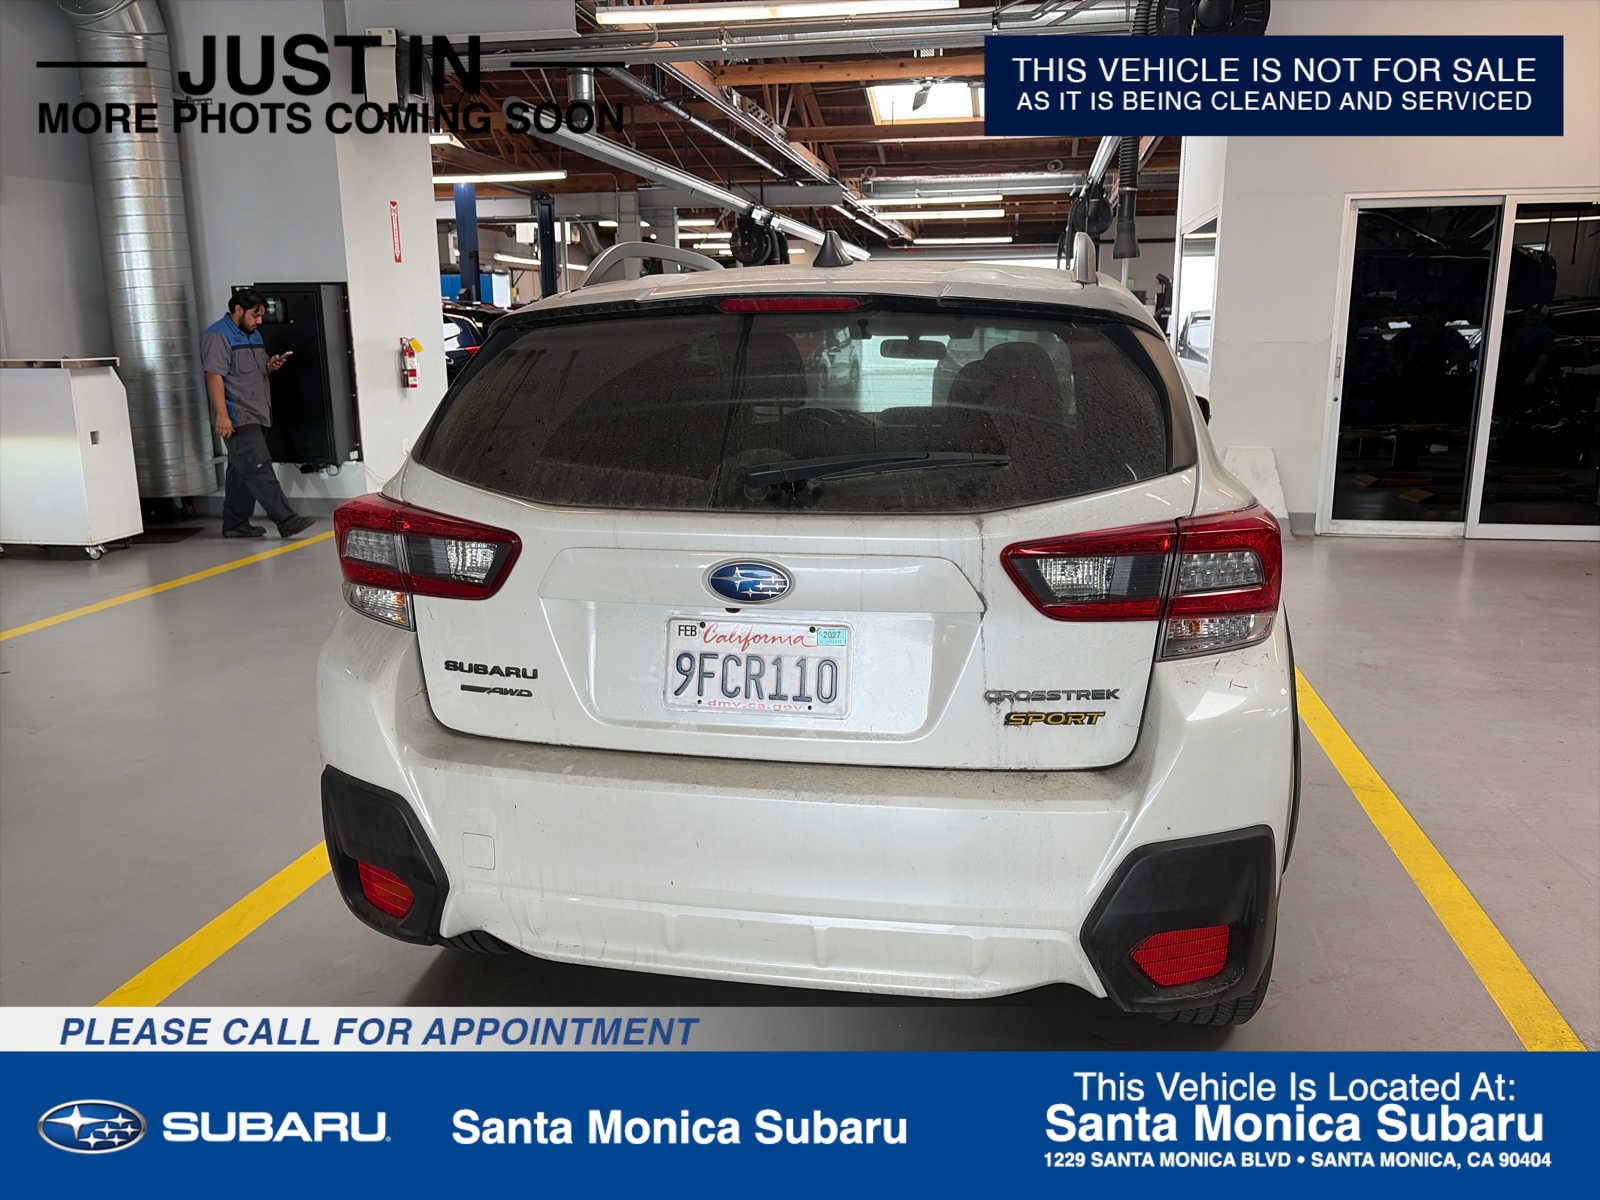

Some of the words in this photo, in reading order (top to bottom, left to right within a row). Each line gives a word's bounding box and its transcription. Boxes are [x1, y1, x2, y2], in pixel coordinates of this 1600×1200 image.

[678, 625, 697, 637] FEB
[703, 622, 817, 651] California
[444, 660, 538, 679] SUBARU
[674, 652, 838, 704] 9FCR110
[487, 687, 533, 697] AWD
[984, 688, 1120, 701] CROSSTREK
[706, 698, 803, 712] dmv.ca.gov
[1004, 711, 1105, 725] SPORT
